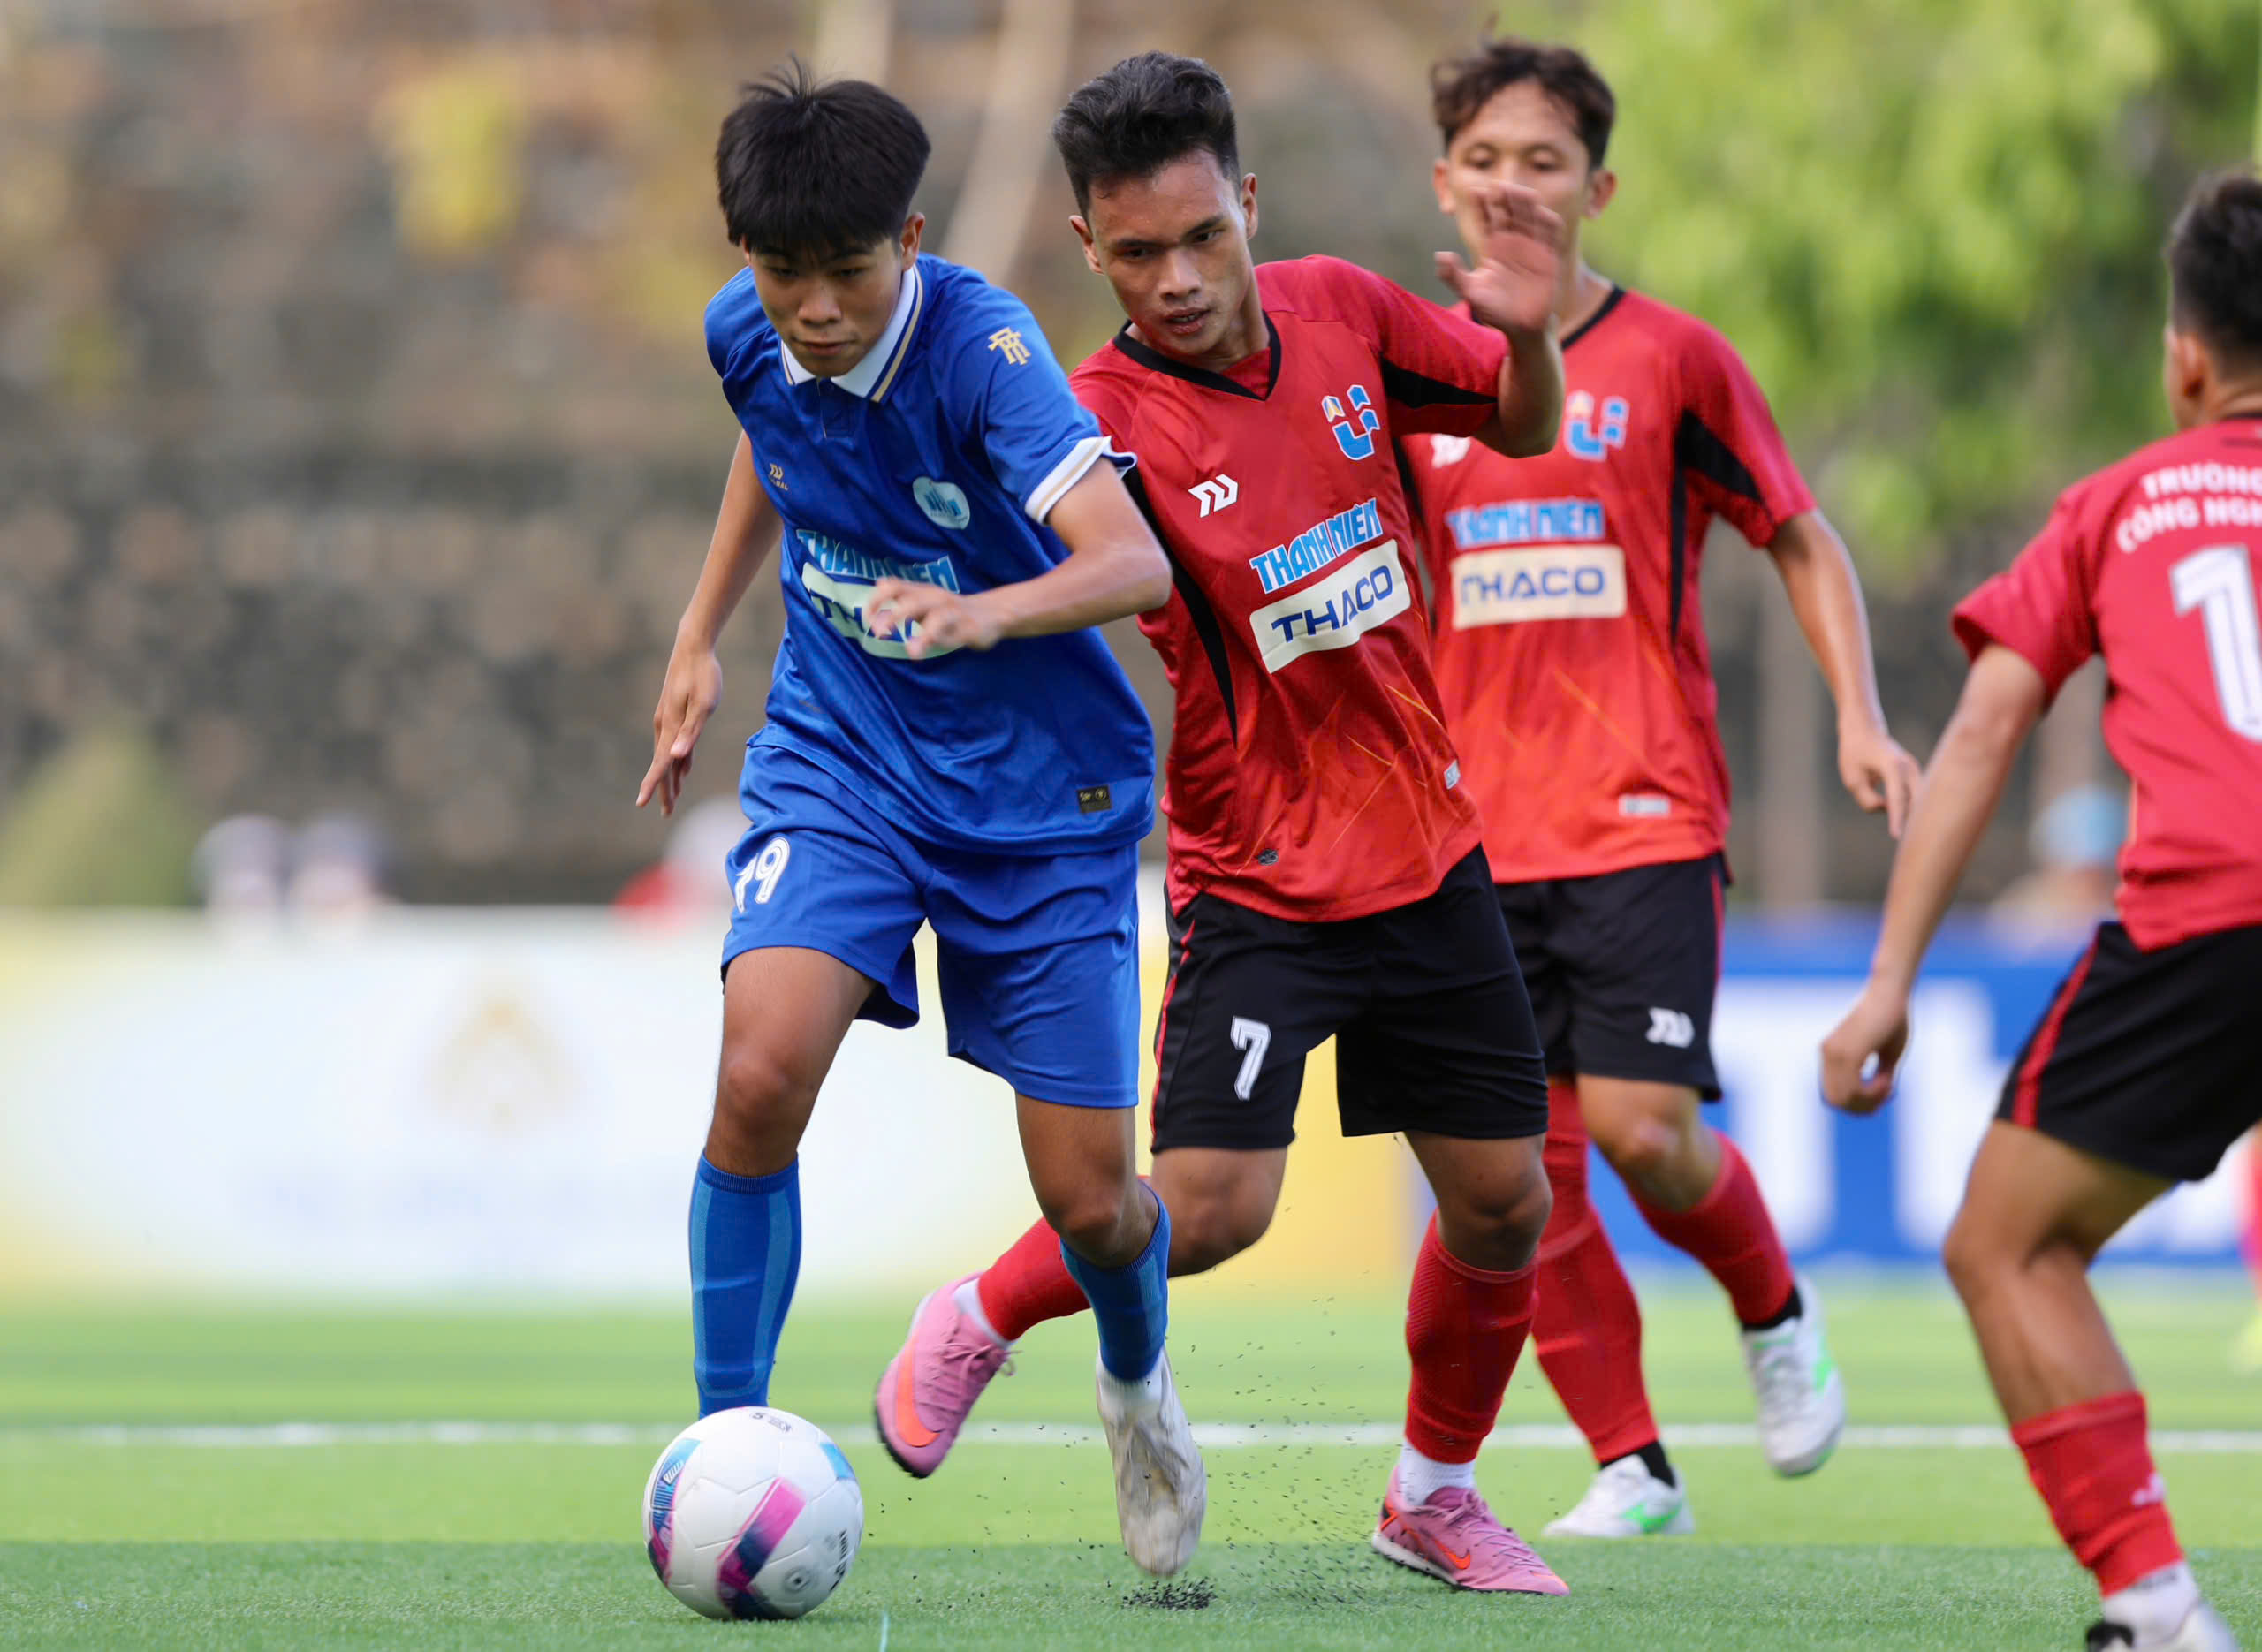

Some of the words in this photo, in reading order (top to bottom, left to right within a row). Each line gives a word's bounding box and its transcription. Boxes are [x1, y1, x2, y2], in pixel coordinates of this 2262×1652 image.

[1249, 521, 1338, 595] THANH
[1461, 567, 1605, 606] THACO
[1271, 565, 1393, 643] THACO
[735, 836, 791, 913] 19
[1230, 1015, 1271, 1101] 7
